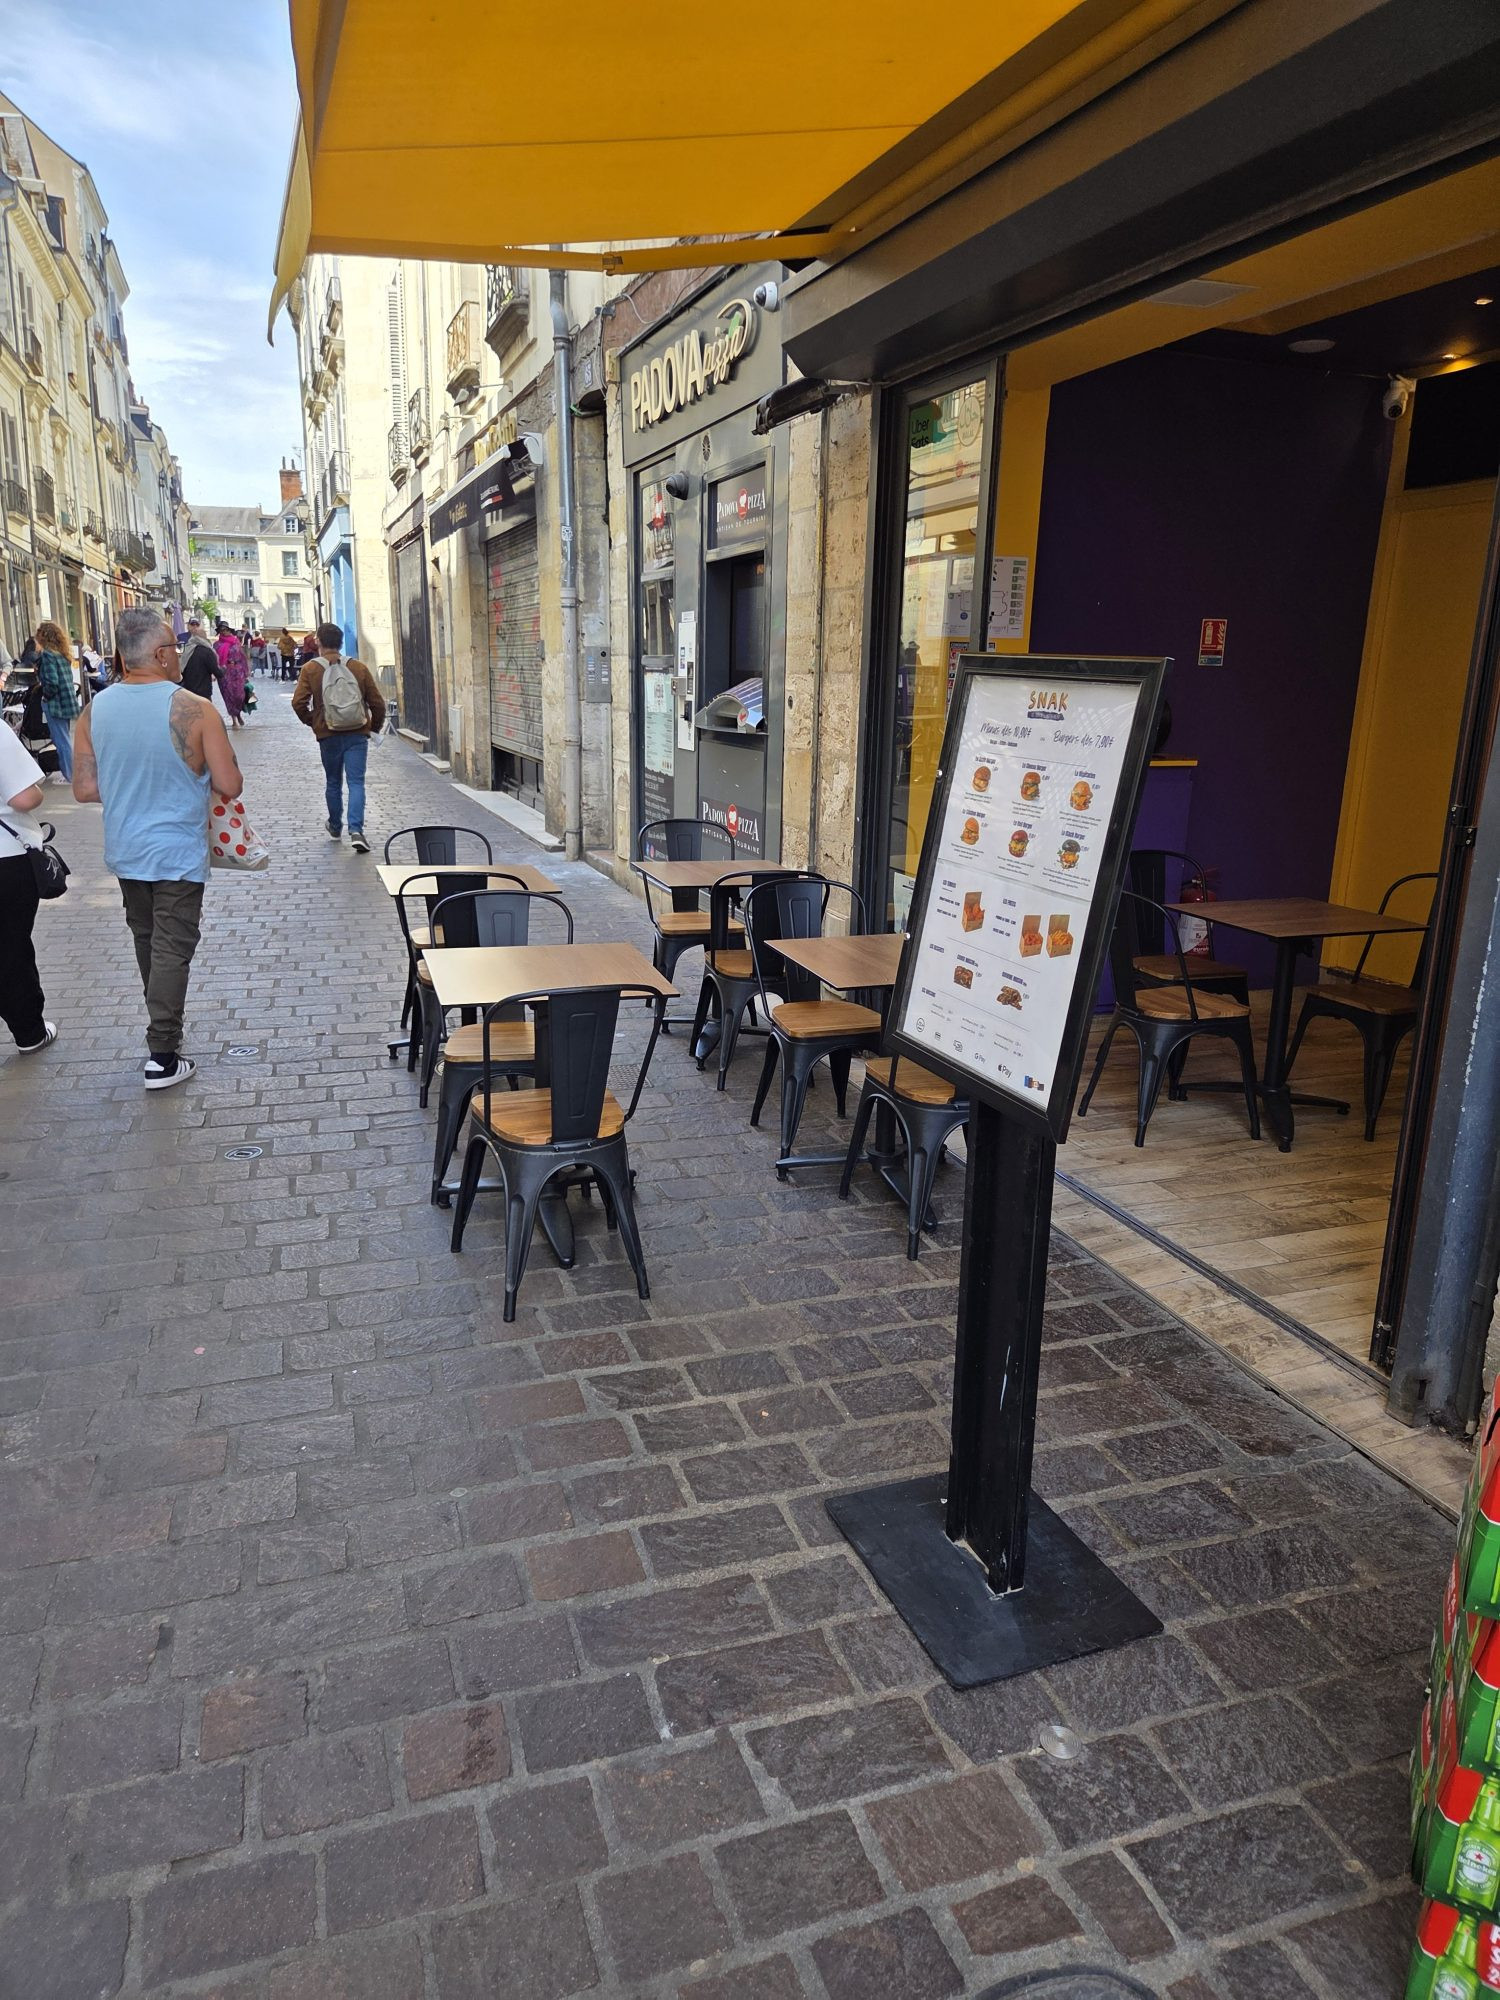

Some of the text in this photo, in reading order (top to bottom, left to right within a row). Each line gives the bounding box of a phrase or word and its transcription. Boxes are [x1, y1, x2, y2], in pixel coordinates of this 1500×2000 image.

[630, 324, 745, 434] PADOVA pizza
[911, 418, 929, 434] Uber
[911, 435, 929, 449] Eats
[747, 488, 766, 511] PIZZA
[1028, 690, 1070, 712] SNAK
[702, 801, 728, 827] PADOVA
[737, 817, 760, 842] PIZZA
[702, 828, 723, 840] ARTISAN
[1457, 1854, 1497, 1877] Heineken
